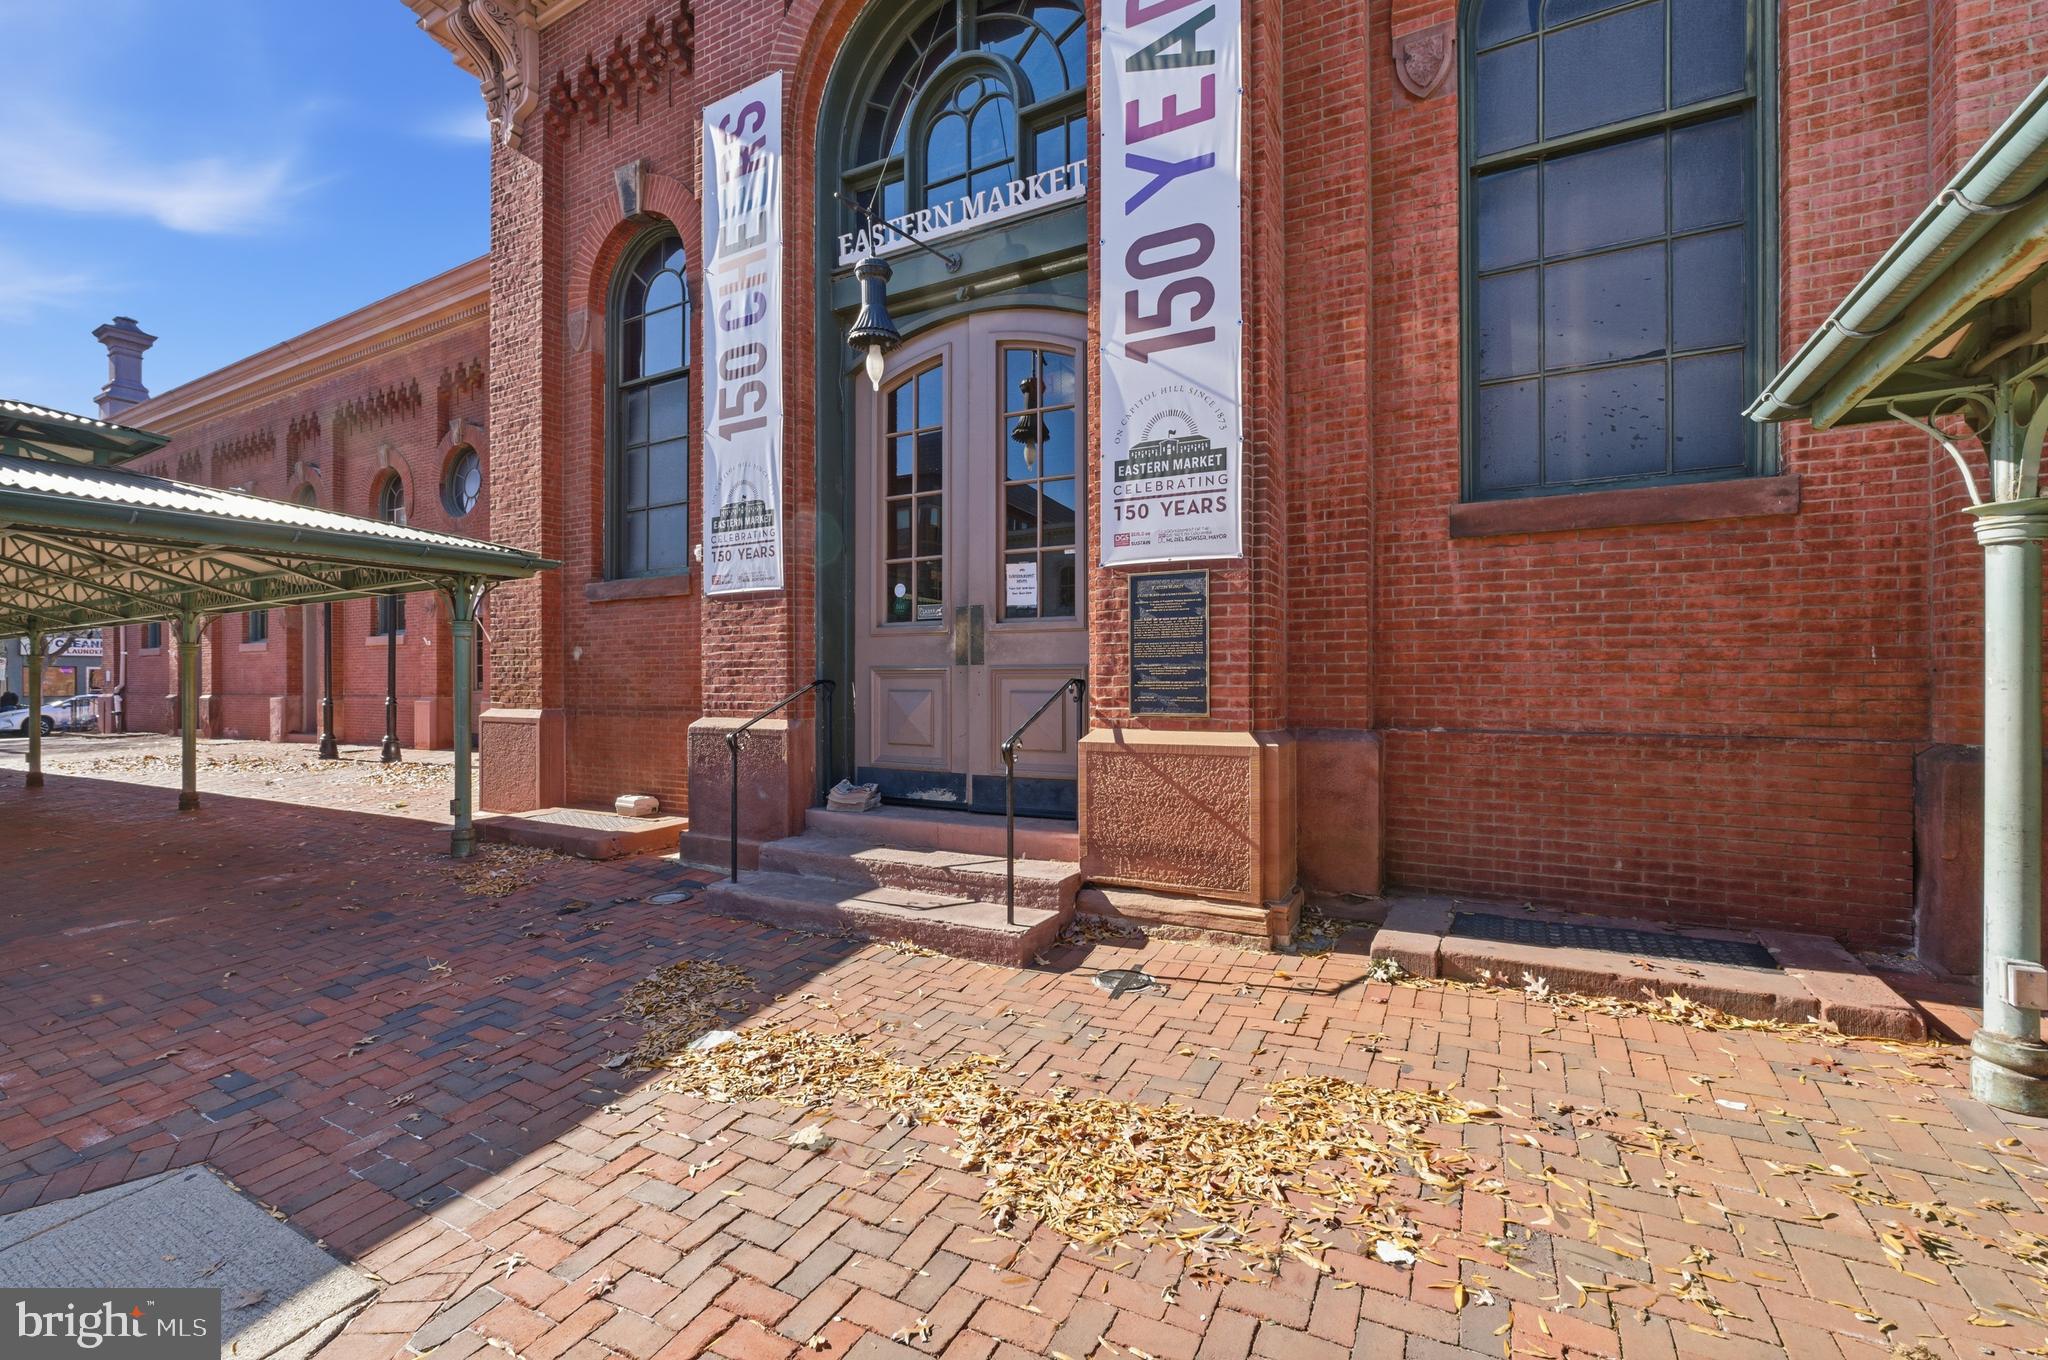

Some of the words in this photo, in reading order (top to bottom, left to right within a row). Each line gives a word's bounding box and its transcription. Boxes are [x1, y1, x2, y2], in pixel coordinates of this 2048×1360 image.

[838, 201, 954, 258] EASTERN
[960, 159, 1087, 221] MARKET
[1125, 222, 1215, 364] 150
[719, 342, 767, 442] 150
[1115, 429, 1123, 445] ON
[1121, 391, 1157, 426] CAPITOL
[1161, 385, 1184, 394] HILL
[1190, 388, 1215, 408] SINCE
[1214, 408, 1228, 430] 1873
[1118, 459, 1169, 477] EASTERN
[1173, 454, 1222, 470] MARKET
[1113, 474, 1229, 496] CELEBRATING
[1113, 503, 1149, 521] 150
[1160, 496, 1228, 517] YEARS
[713, 518, 742, 530] EASTERN
[745, 514, 772, 525] MARKET
[711, 528, 776, 544] CELEBRATING
[712, 550, 732, 563] 150
[738, 545, 775, 561] YEARS
